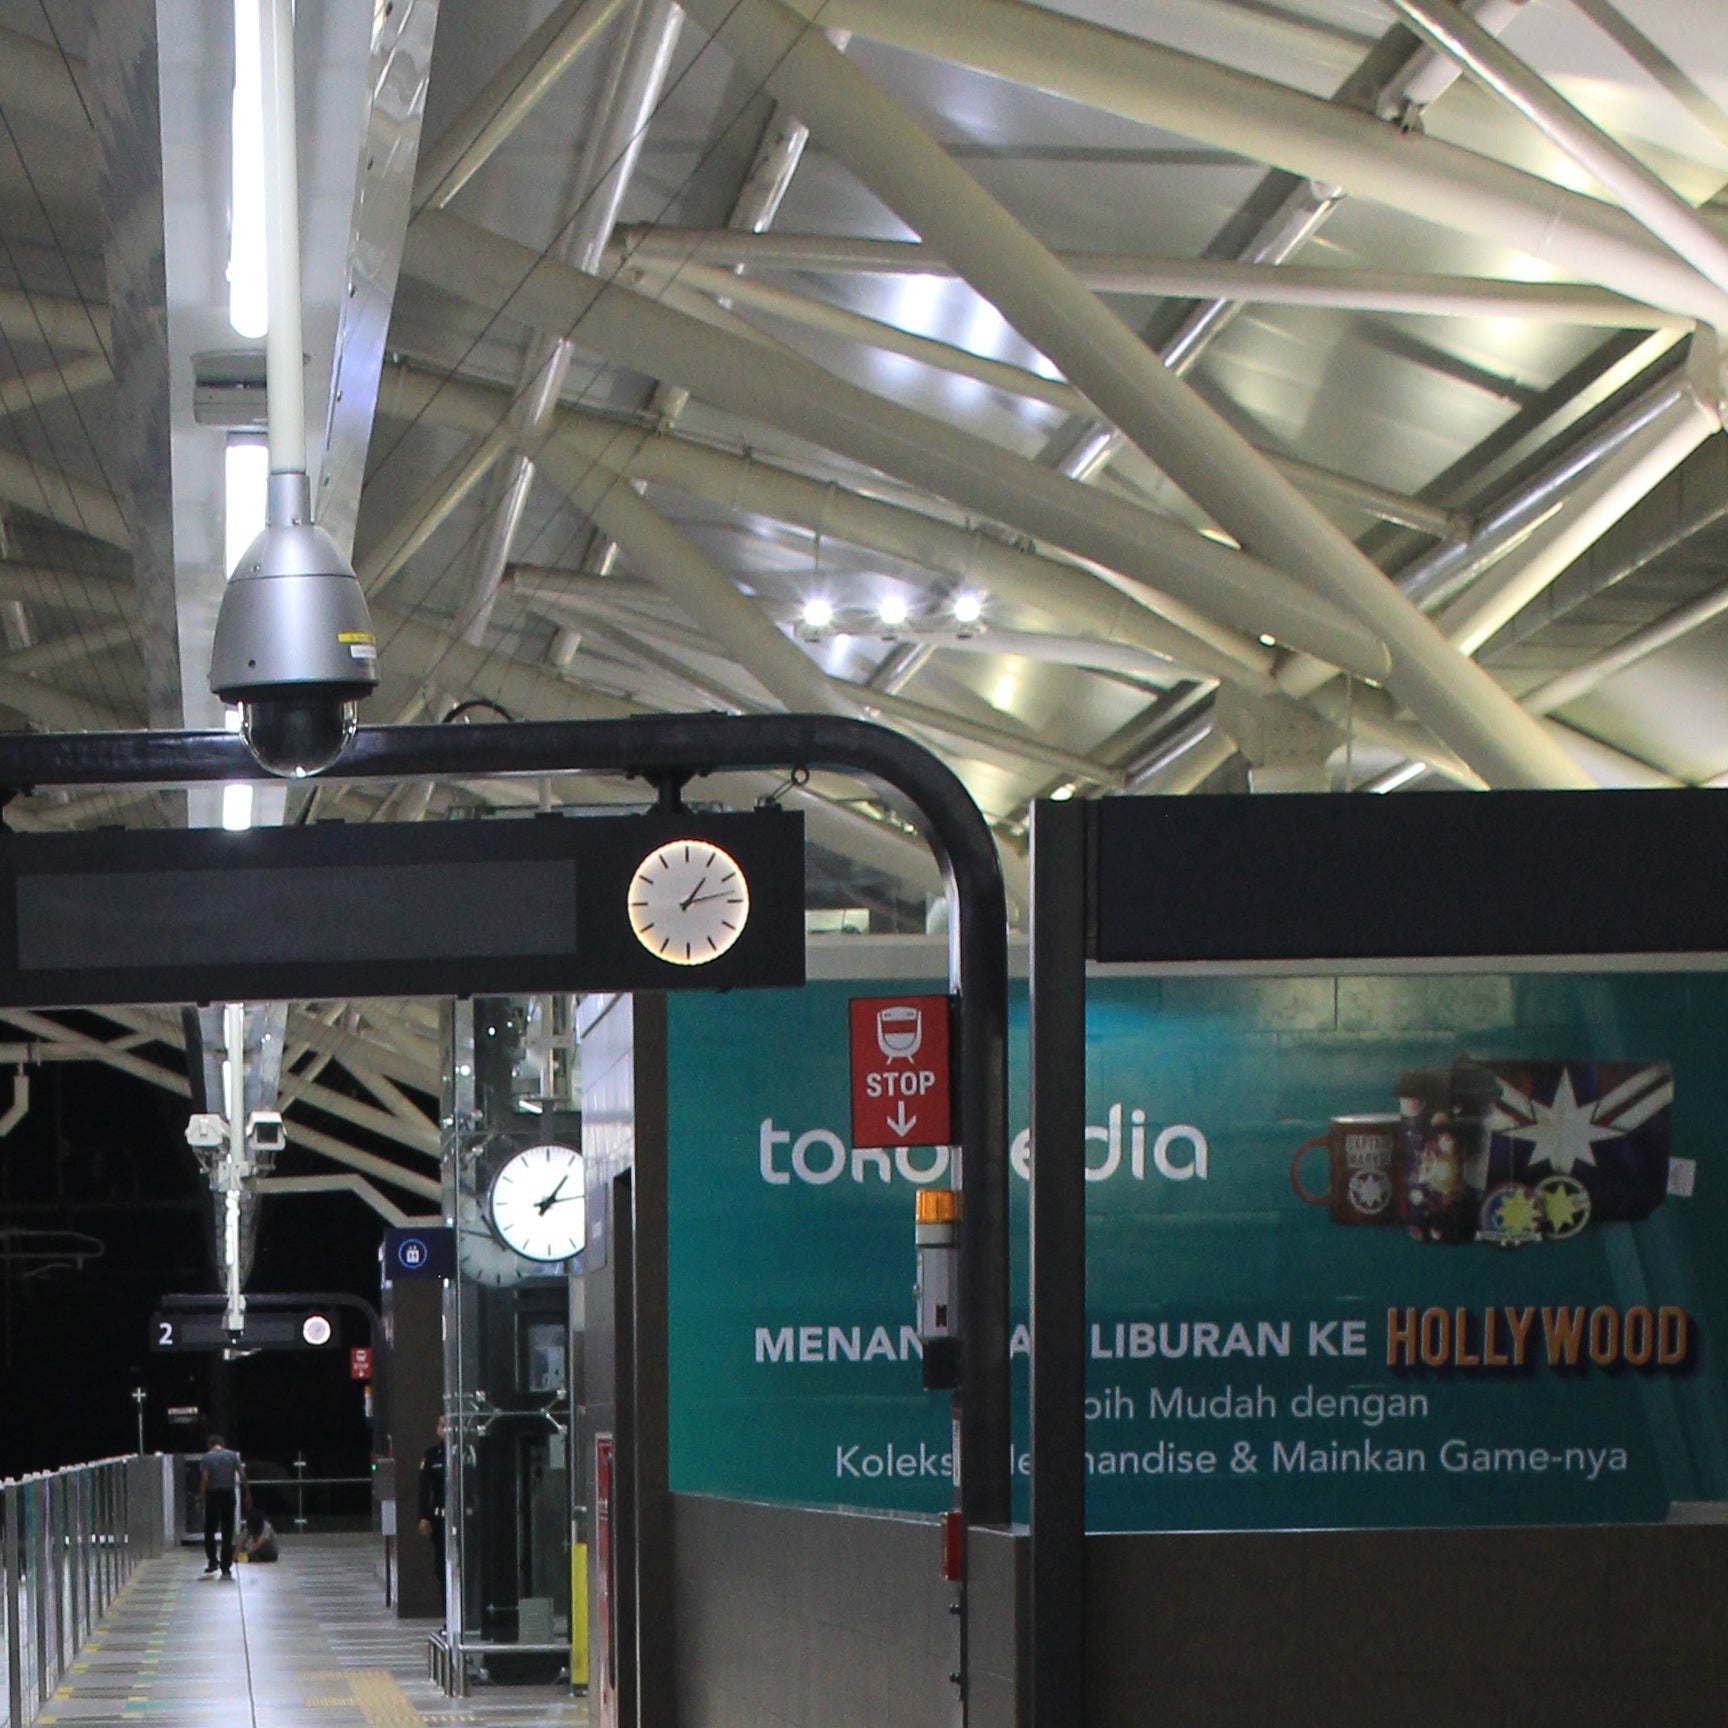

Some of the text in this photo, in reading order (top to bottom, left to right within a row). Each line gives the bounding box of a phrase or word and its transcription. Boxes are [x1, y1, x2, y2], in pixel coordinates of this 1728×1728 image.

[866, 1071, 935, 1098] STOP
[159, 1322, 173, 1345] 2
[1090, 1321, 1290, 1359] LIBURAN
[1308, 1320, 1368, 1356] KE
[1386, 1305, 1688, 1367] HOLLYWOOD
[1149, 1384, 1276, 1419] Mudah
[1291, 1384, 1429, 1426] dengan
[835, 1443, 954, 1478] Koleks
[1230, 1440, 1258, 1474] &
[1272, 1438, 1425, 1474] Mainkan
[1440, 1439, 1628, 1480] Game-nya
